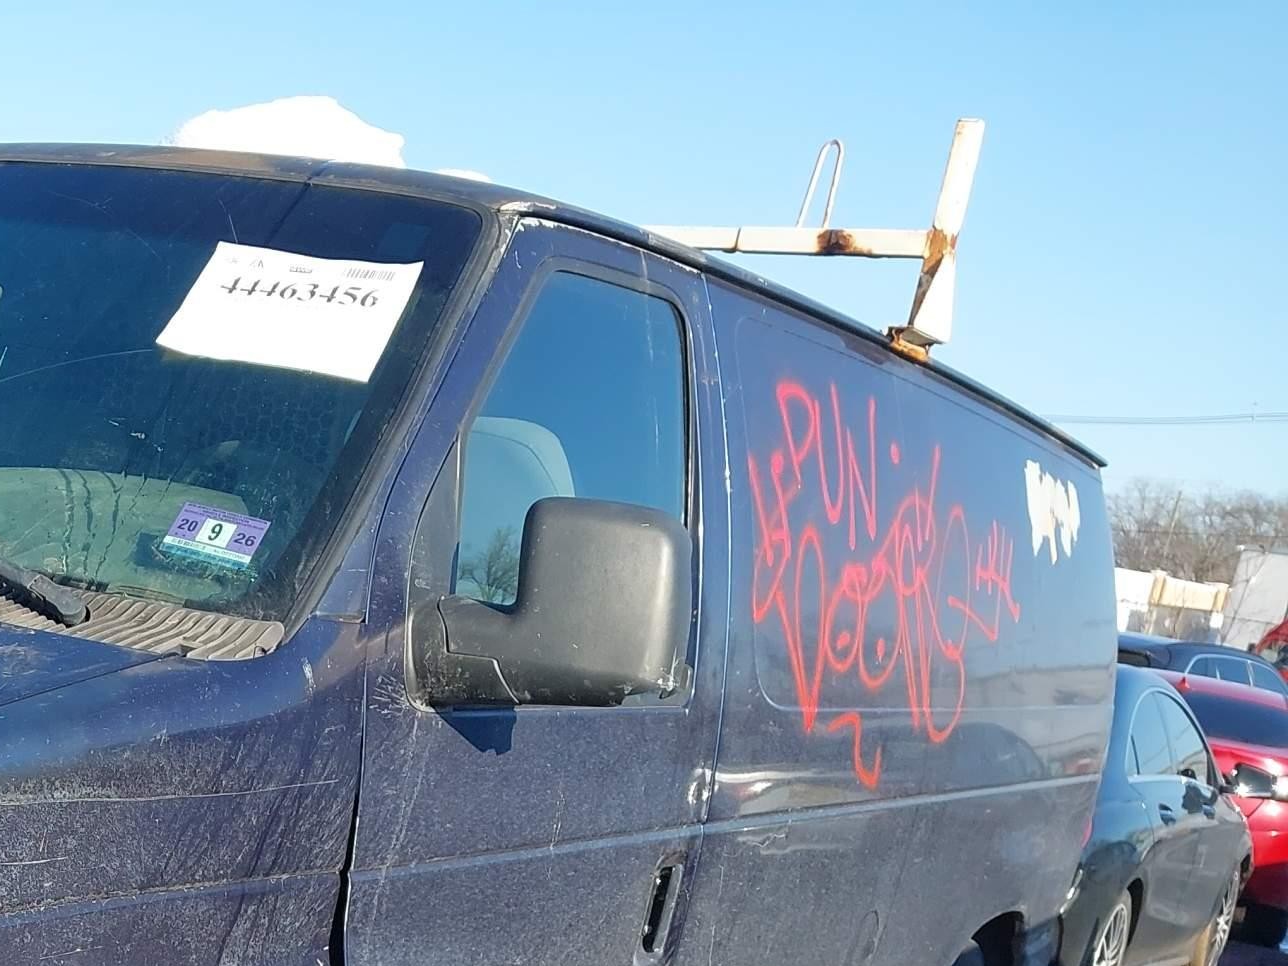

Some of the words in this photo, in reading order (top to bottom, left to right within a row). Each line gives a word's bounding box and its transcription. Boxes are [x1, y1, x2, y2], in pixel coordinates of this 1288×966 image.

[220, 275, 380, 307] 44463456
[177, 518, 199, 532] 20
[207, 523, 224, 541] 9
[233, 532, 257, 547] 26
